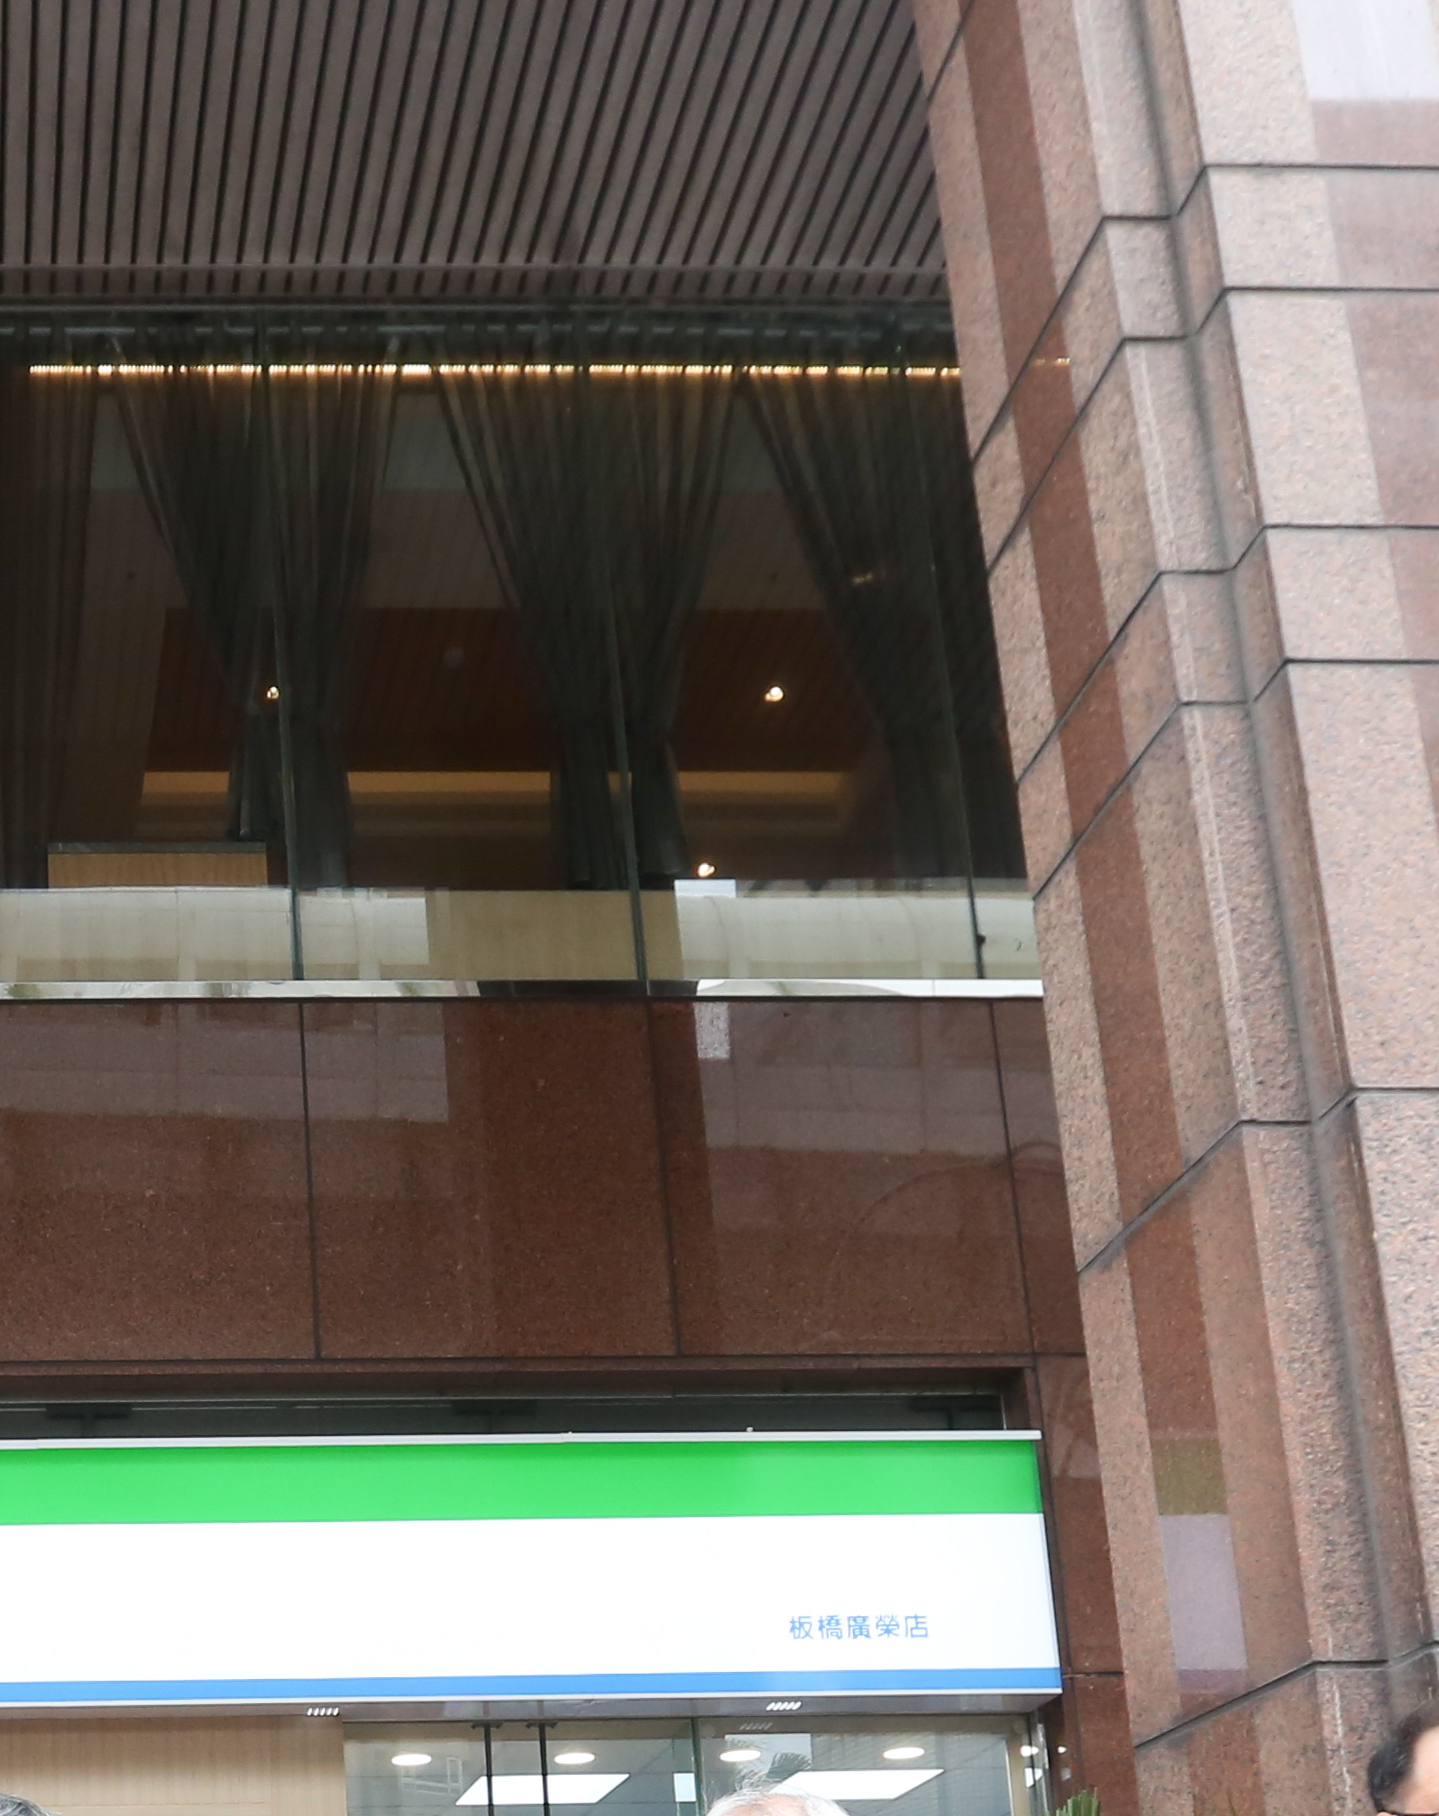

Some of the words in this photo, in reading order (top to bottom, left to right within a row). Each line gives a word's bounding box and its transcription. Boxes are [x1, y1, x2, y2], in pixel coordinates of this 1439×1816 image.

[789, 1615, 929, 1640] 板橋廣榮店
